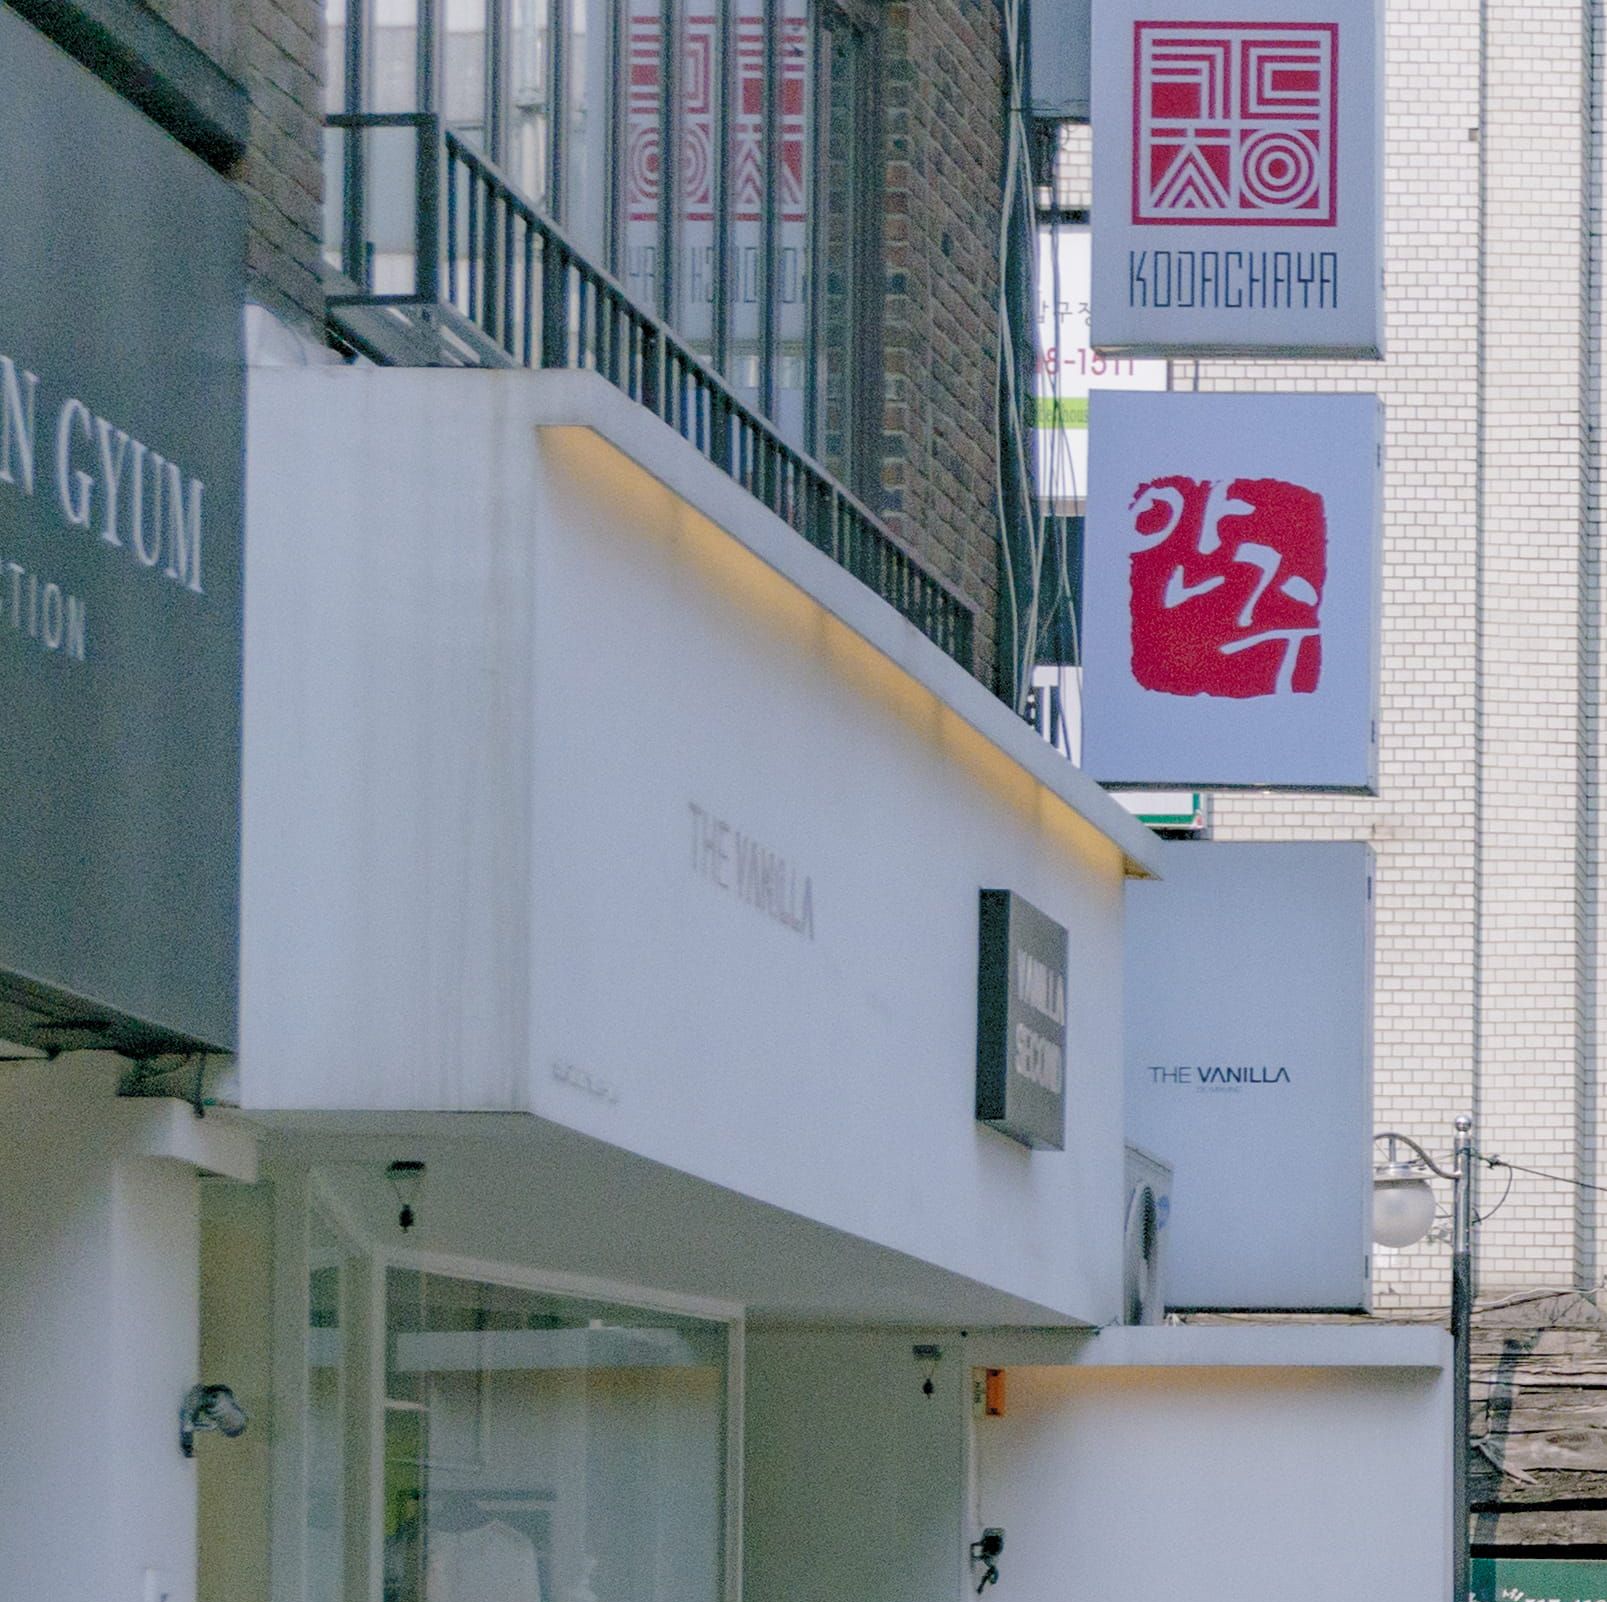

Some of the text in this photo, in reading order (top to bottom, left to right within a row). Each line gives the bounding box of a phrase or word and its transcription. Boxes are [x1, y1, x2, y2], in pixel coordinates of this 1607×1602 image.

[1130, 251, 1338, 309] KODACHAYA
[55, 399, 205, 593] GYUM
[0, 559, 87, 661] TION
[1148, 1066, 1290, 1083] THE VANILLA
